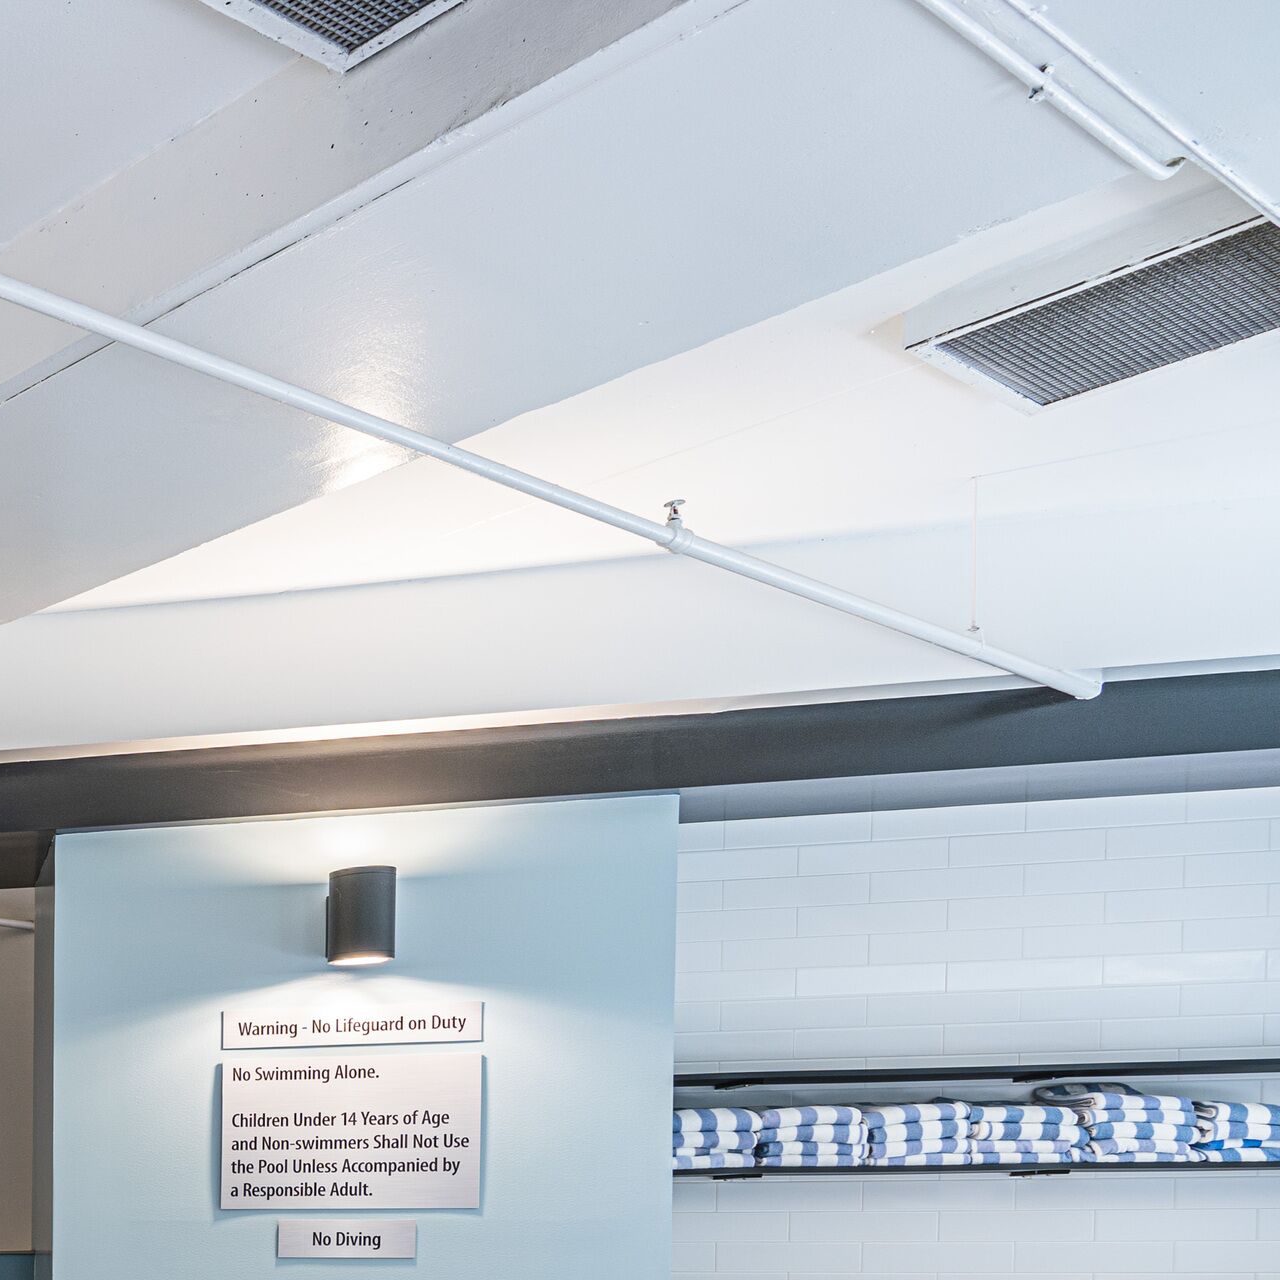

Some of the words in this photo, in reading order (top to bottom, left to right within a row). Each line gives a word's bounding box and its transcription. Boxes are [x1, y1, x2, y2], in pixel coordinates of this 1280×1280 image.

[238, 1020, 298, 1039] Warning
[312, 1019, 331, 1034] No
[335, 1015, 404, 1036] Lifeguard
[408, 1019, 427, 1031] on
[431, 1014, 467, 1033] Duty
[232, 1067, 251, 1082] No
[254, 1065, 330, 1084] Swimming
[334, 1064, 380, 1080] Alone.
[231, 1112, 289, 1128] Children
[293, 1111, 337, 1127] Under
[340, 1111, 358, 1126] 14
[360, 1111, 399, 1126] Years
[402, 1109, 419, 1125] of
[421, 1110, 450, 1128] Age
[231, 1136, 258, 1151] and
[261, 1135, 370, 1151] Non-swimmers
[373, 1133, 408, 1149] Shall
[413, 1133, 440, 1149] Not
[443, 1133, 470, 1149] Use
[230, 1159, 255, 1174] the
[258, 1158, 288, 1174] Pool
[292, 1158, 338, 1174] Unless
[341, 1157, 438, 1177] Accompanied
[442, 1156, 461, 1176] by
[230, 1186, 239, 1198] a
[243, 1182, 326, 1201] Responsible
[329, 1181, 373, 1197] Adult.
[312, 1231, 332, 1247] No
[335, 1231, 381, 1251] Diving
